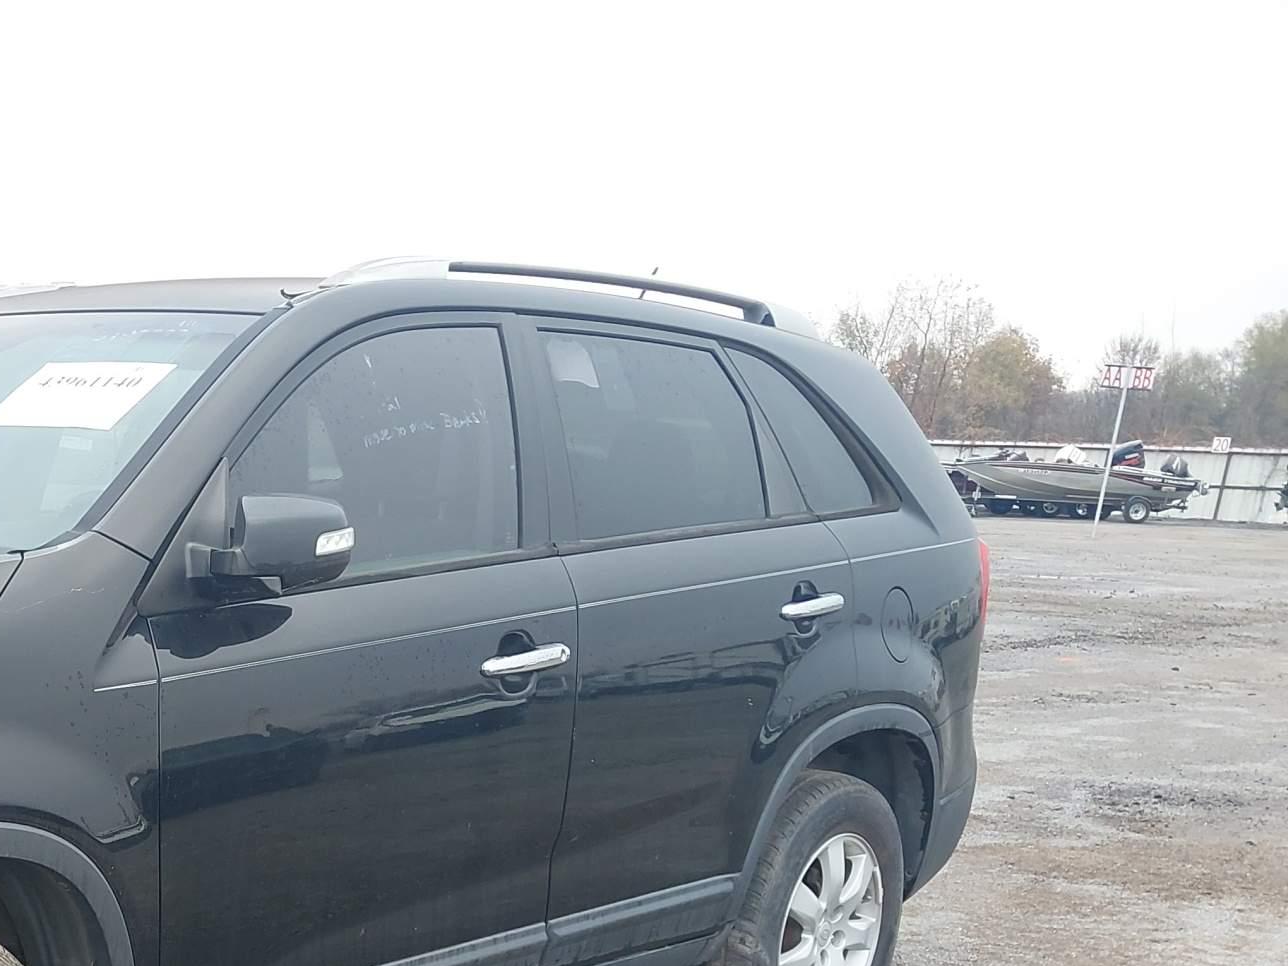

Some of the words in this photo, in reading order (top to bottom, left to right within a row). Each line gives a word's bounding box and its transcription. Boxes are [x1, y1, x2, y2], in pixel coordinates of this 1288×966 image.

[1101, 366, 1122, 388] AA
[1133, 368, 1153, 390] BB
[1213, 438, 1229, 452] 20
